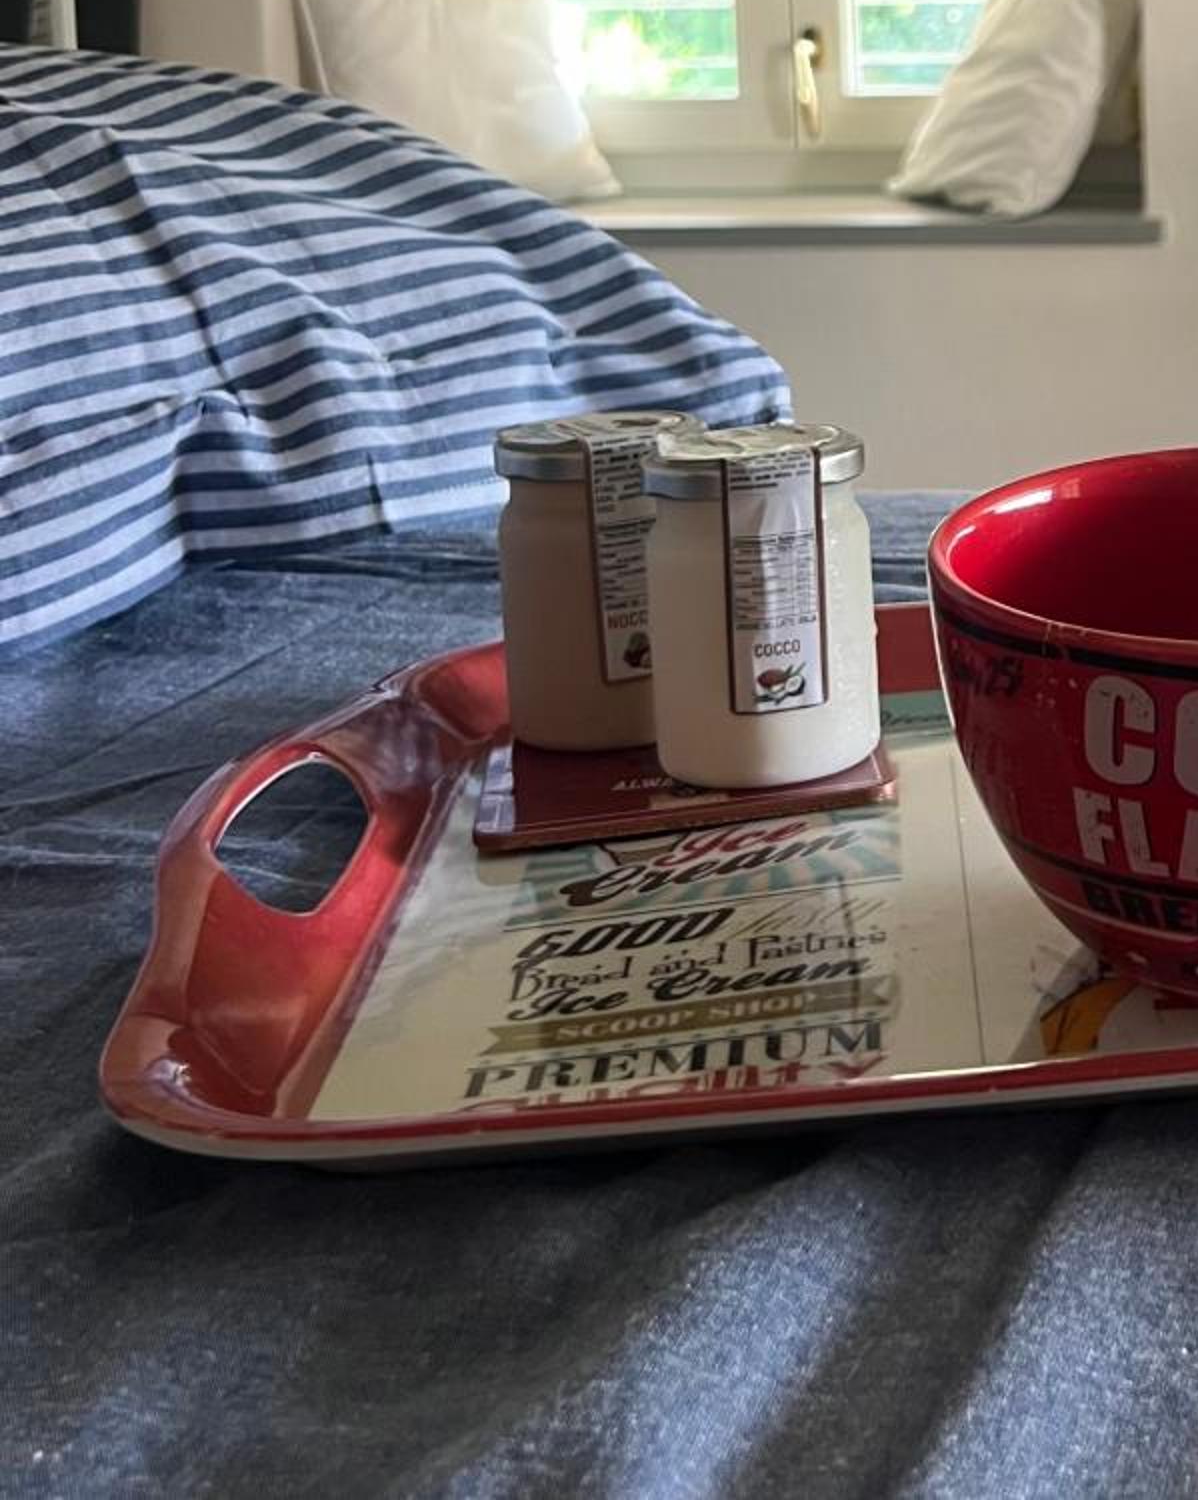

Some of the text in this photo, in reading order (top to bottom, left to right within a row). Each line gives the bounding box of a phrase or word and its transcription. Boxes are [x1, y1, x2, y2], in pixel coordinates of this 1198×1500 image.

[754, 639, 801, 658] COCCO
[611, 777, 673, 791] ALWA
[559, 827, 866, 908] Cream
[506, 955, 872, 1022] Ice Cream
[511, 955, 633, 1002] Bread
[555, 992, 818, 1044] SCOOP SHOP
[461, 1019, 885, 1099] PREMIUM
